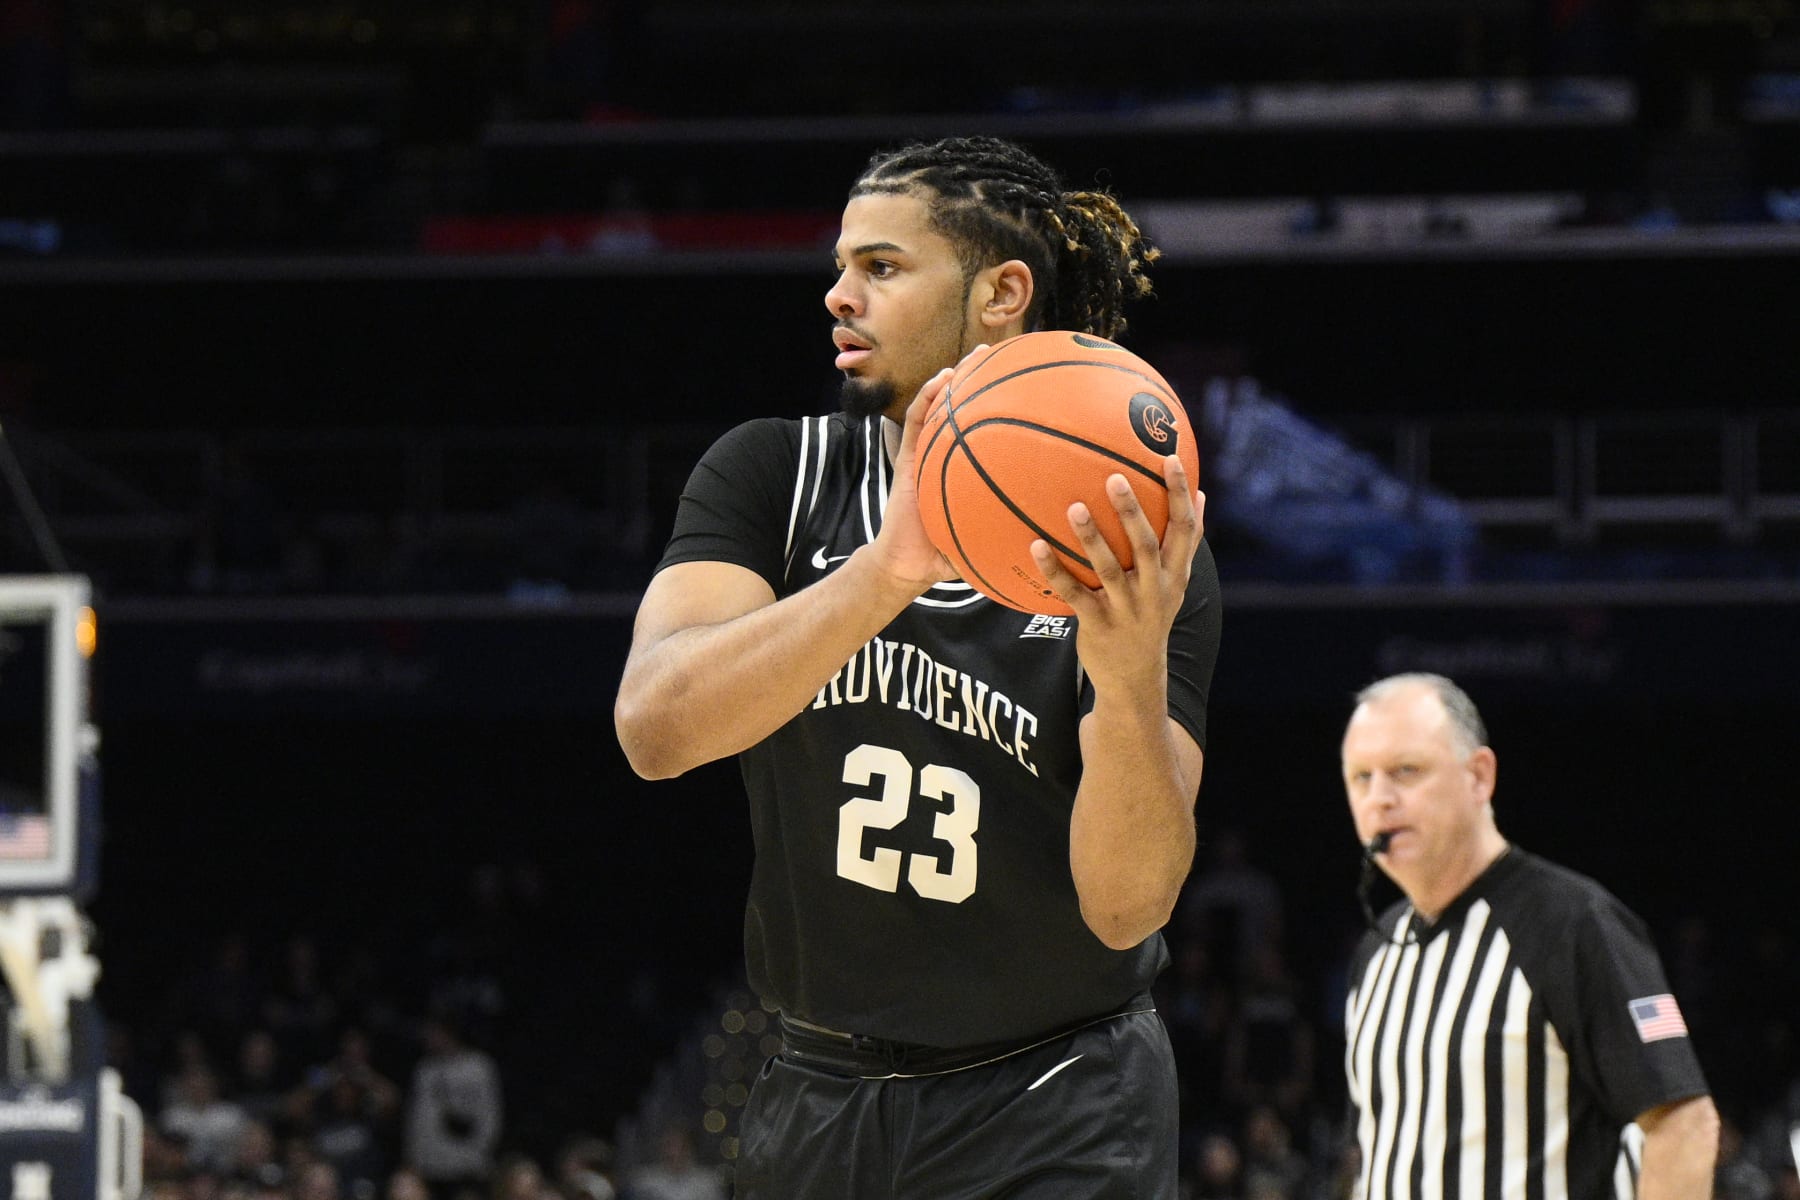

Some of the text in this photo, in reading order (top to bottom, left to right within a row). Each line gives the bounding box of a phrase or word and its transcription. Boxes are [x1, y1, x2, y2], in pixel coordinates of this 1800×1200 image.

[1030, 614, 1067, 627] BIG
[801, 637, 1039, 778] OVIDENCE
[837, 743, 980, 904] 23
